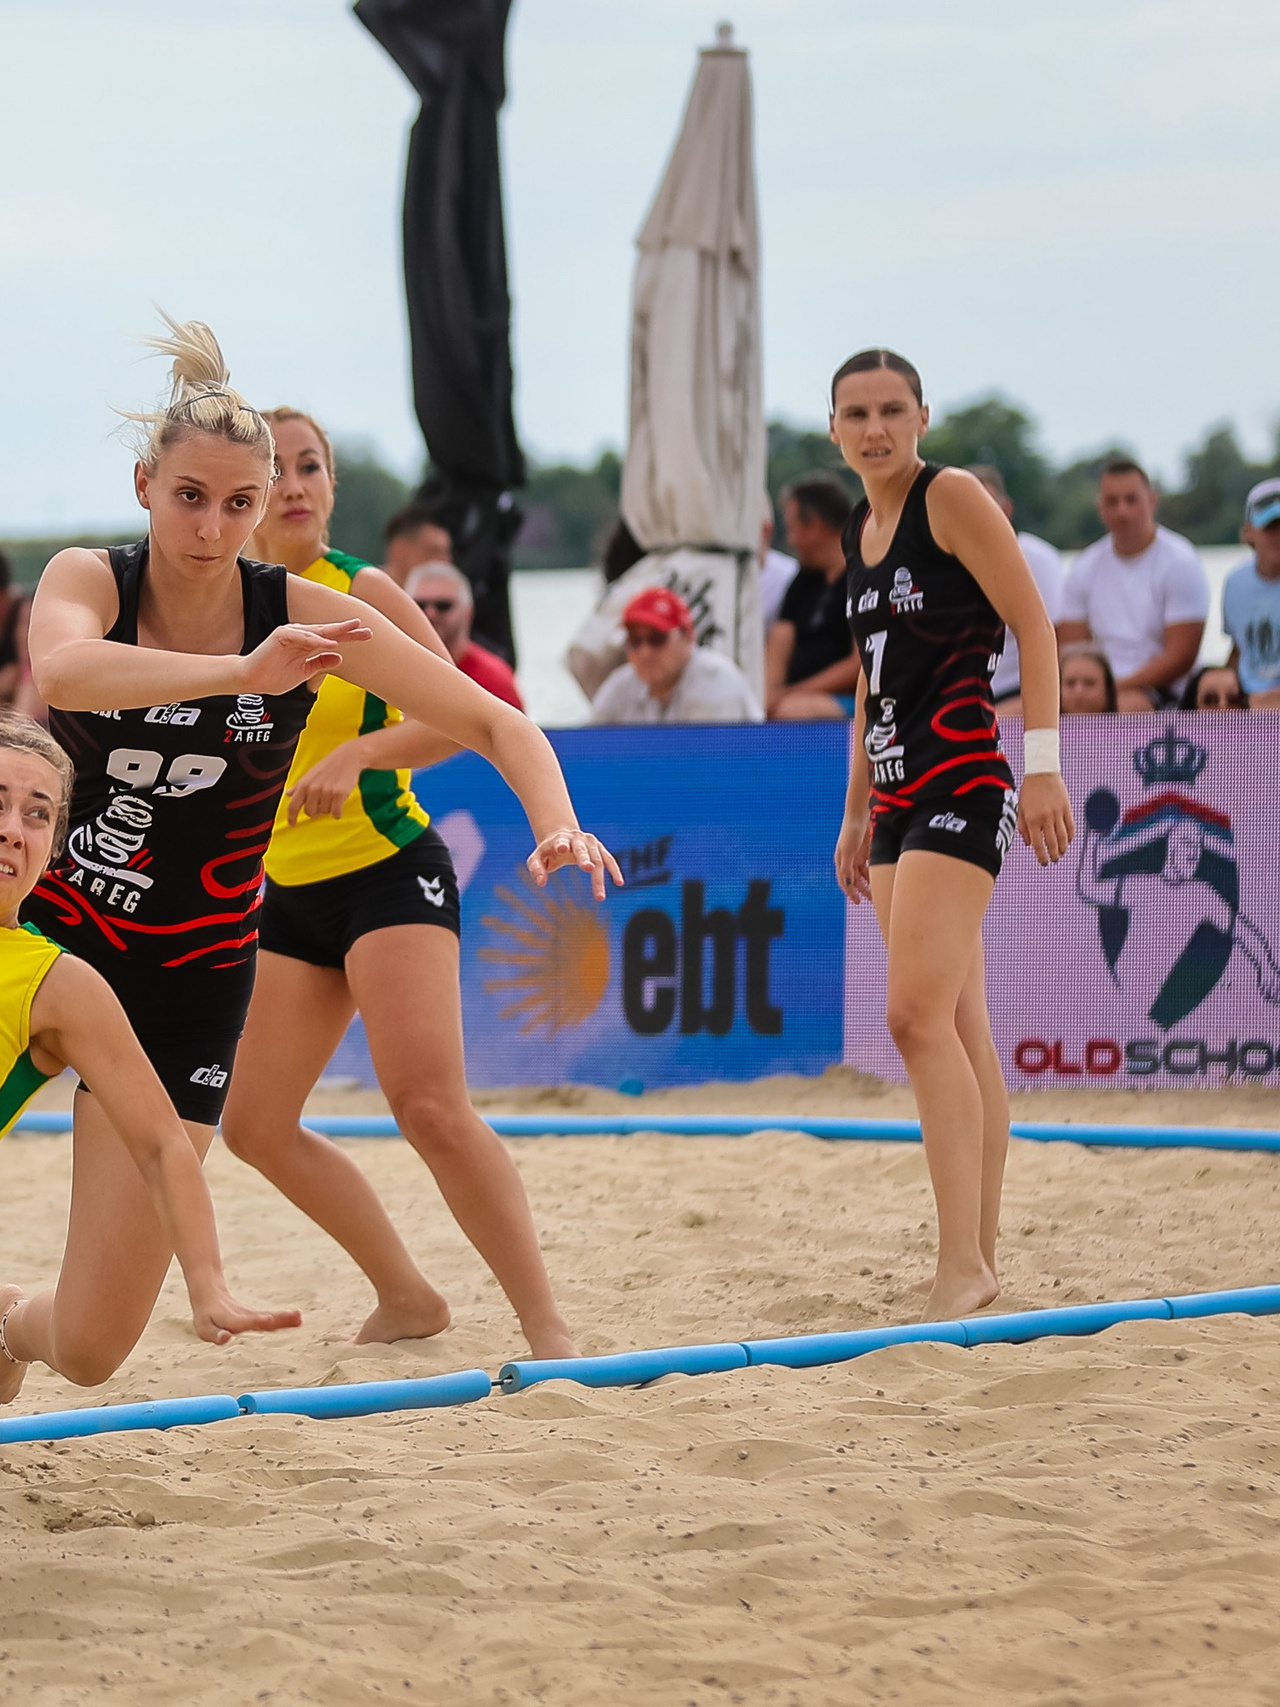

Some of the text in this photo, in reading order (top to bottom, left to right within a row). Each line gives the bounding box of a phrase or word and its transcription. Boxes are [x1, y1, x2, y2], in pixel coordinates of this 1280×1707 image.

[106, 748, 228, 798] 99
[624, 880, 784, 1035] ebt
[1015, 1038, 1280, 1075] OLDSCHO
